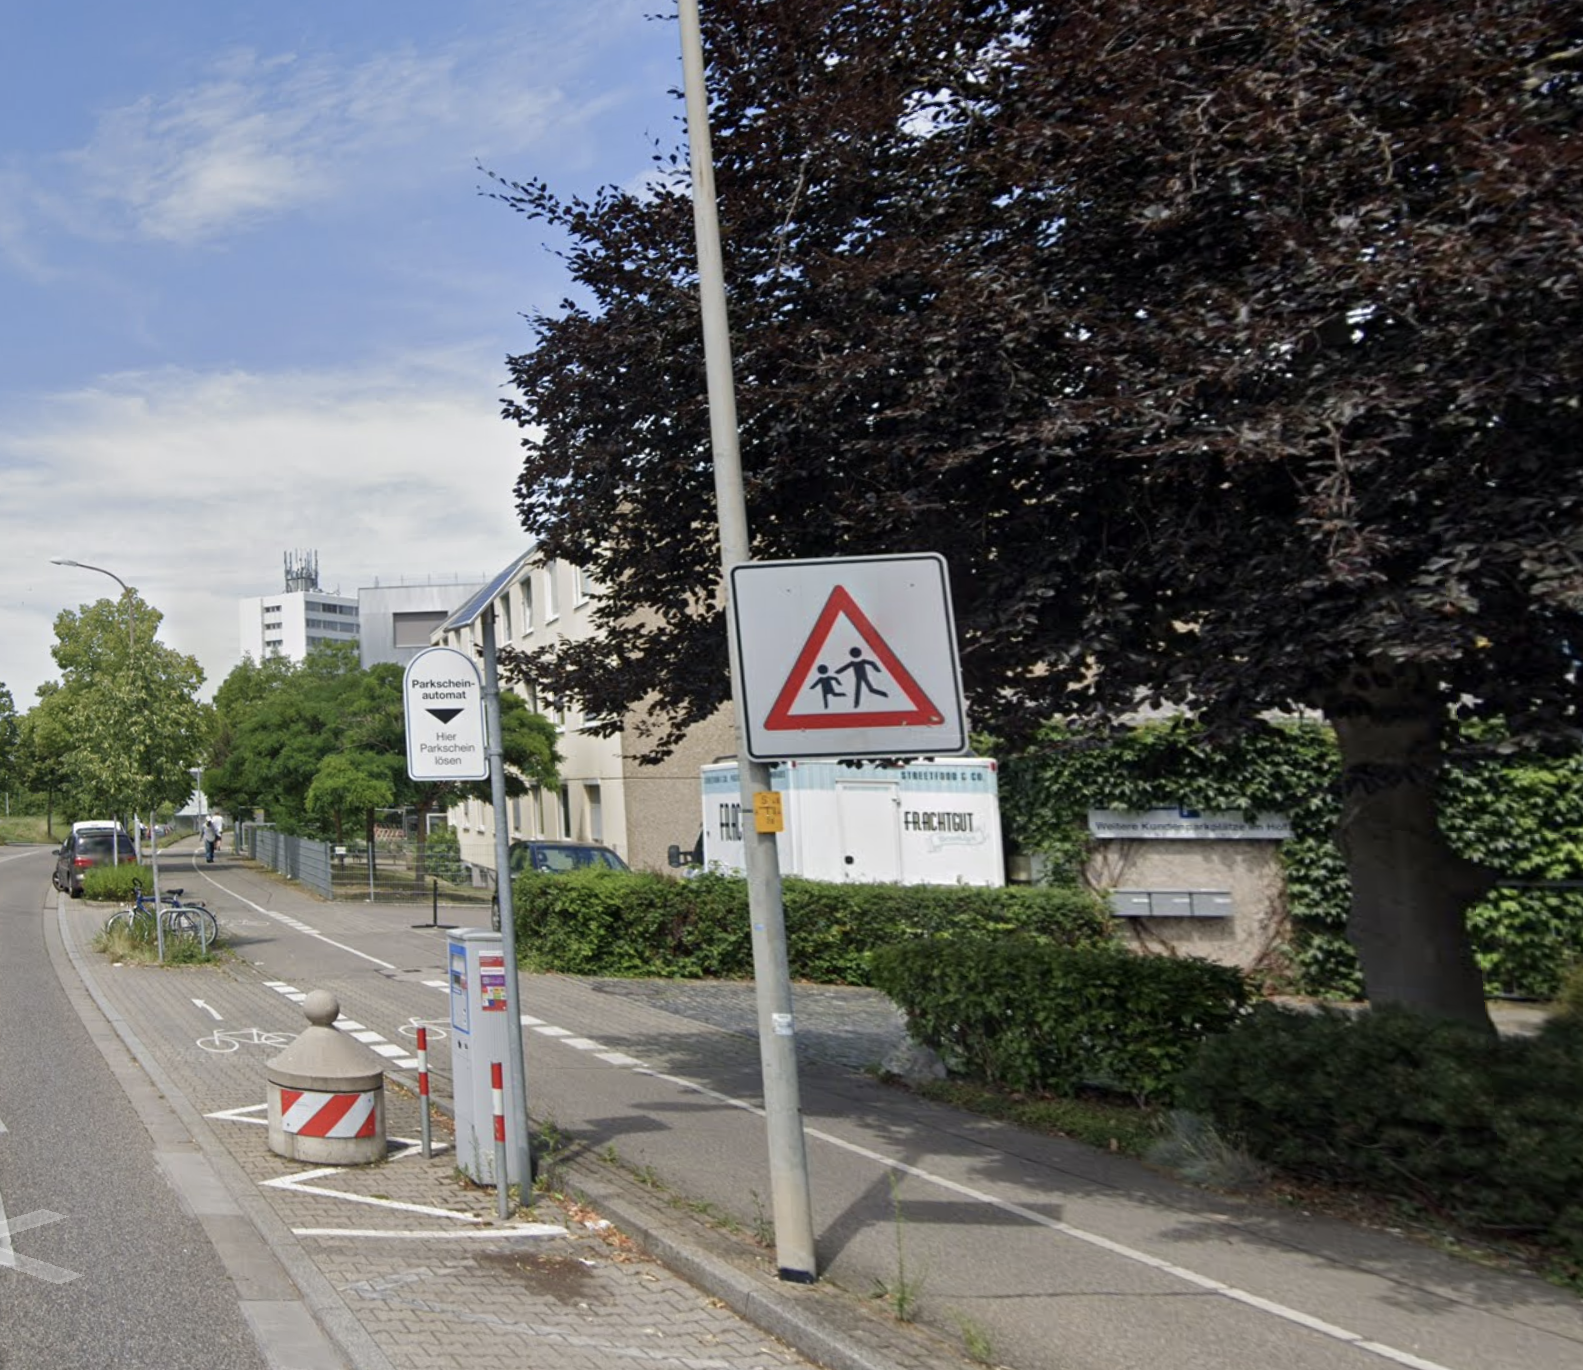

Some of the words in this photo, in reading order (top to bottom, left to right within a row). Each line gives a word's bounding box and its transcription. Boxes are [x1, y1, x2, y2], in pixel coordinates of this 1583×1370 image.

[412, 679, 475, 688] Parkschein-
[422, 691, 467, 700] automat
[436, 732, 457, 741] Hier
[420, 743, 475, 753] Parkschein
[435, 755, 462, 766] lösen
[901, 771, 958, 781] STREETFOOD
[904, 811, 974, 832] FRACHTGUT
